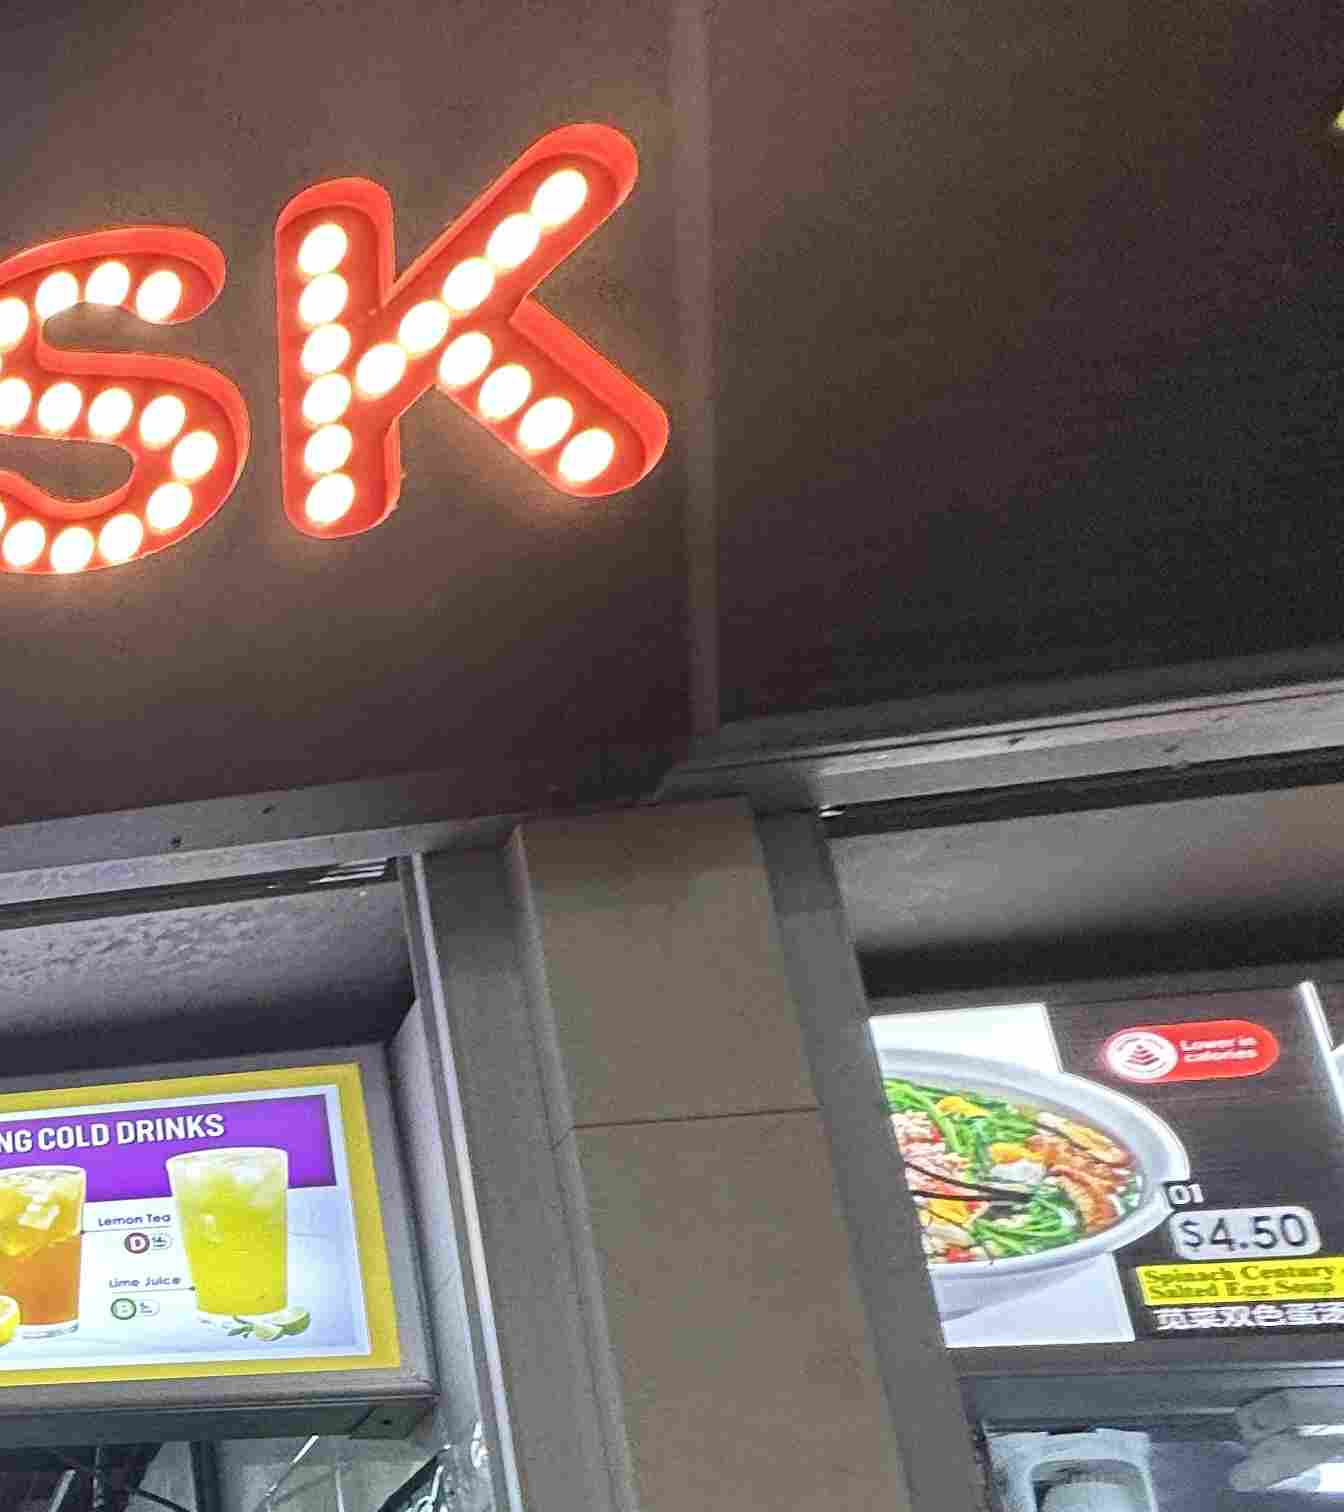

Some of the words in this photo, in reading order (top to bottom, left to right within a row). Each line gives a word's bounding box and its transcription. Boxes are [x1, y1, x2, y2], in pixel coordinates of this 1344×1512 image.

[37, 1122, 110, 1151] COLD
[116, 1113, 225, 1145] DRINKS
[98, 1216, 143, 1227] Lemon
[146, 1213, 172, 1224] Tea
[1181, 1212, 1309, 1252] $4.50
[109, 1276, 141, 1288] Lime
[144, 1275, 182, 1288] Juice
[1144, 1266, 1236, 1285] Spinach
[1240, 1264, 1336, 1282] Century
